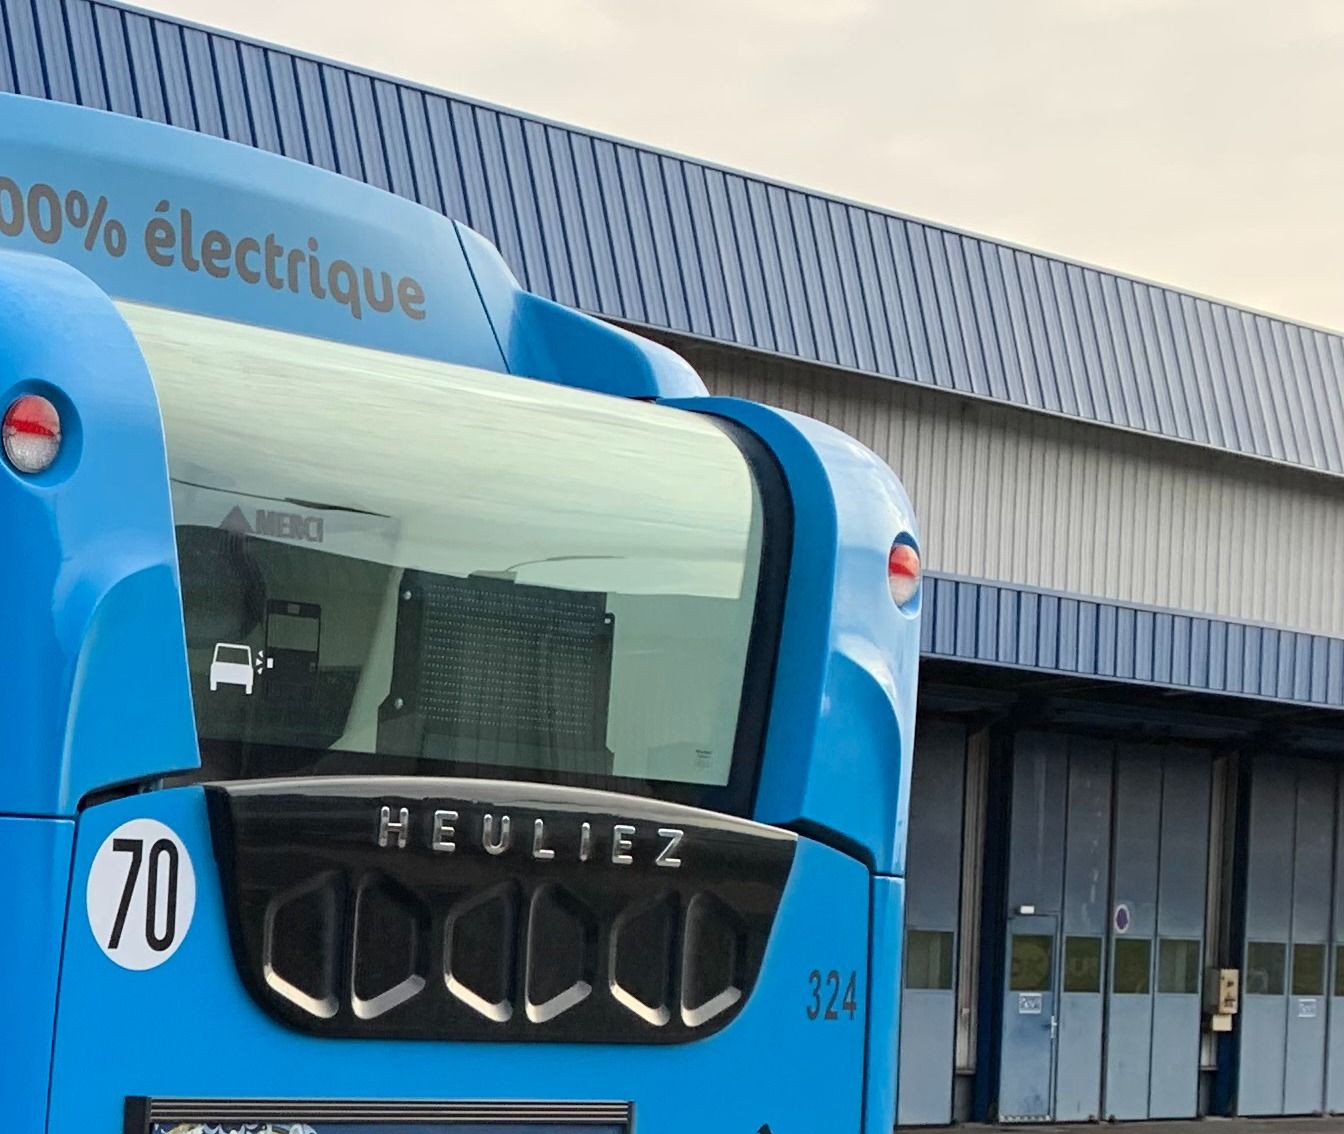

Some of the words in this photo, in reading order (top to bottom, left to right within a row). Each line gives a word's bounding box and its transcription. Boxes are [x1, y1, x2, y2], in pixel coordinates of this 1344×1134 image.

[144, 200, 427, 321] électrique
[255, 508, 324, 543] MERCI
[378, 804, 686, 868] HEULIEZ
[108, 838, 179, 952] 70
[806, 969, 857, 1021] 324
